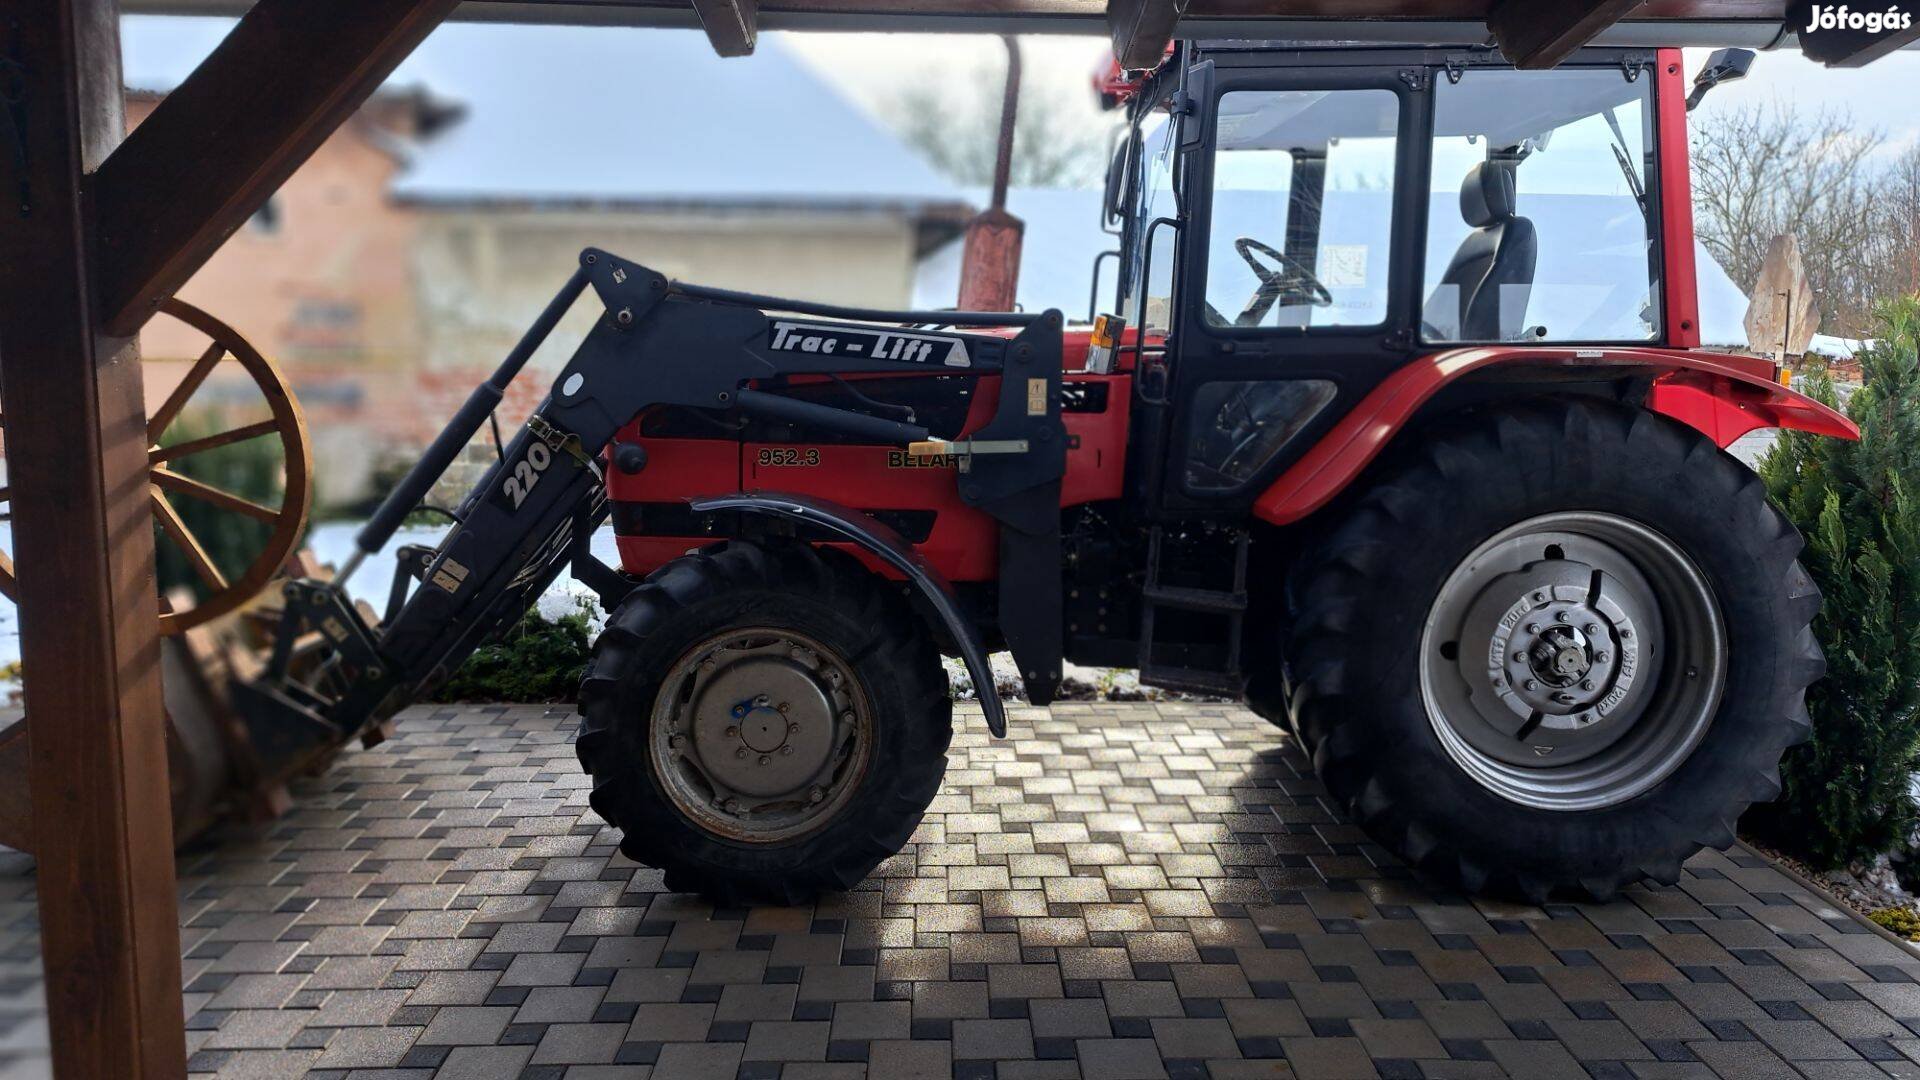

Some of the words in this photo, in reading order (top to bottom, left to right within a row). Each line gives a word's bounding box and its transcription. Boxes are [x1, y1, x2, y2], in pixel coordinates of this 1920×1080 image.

[771, 321, 838, 353] Trac
[870, 332, 932, 362] Lift
[758, 449, 820, 467] 952.3
[888, 451, 958, 468] BELAR
[503, 442, 550, 509] 220
